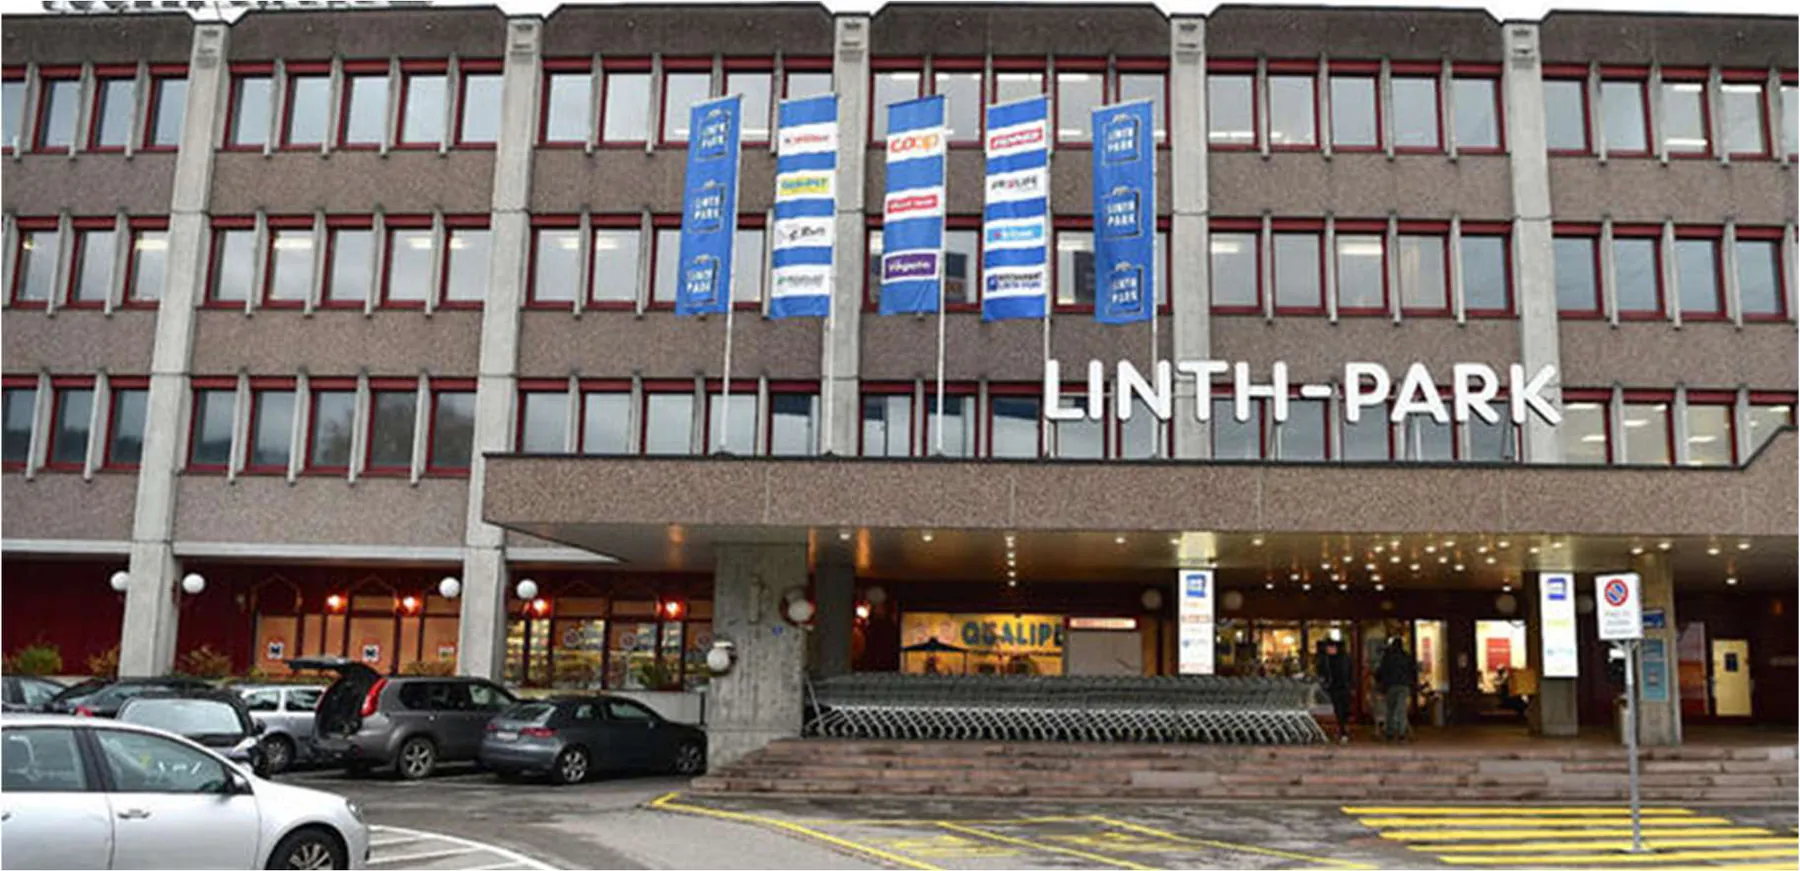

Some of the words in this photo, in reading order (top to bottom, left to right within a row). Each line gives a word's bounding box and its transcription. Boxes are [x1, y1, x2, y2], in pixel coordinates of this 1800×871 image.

[701, 135, 724, 148] PARK
[890, 133, 938, 154] coop
[1107, 140, 1134, 153] PARK
[694, 208, 720, 220] PARK
[1106, 200, 1135, 214] LINTH
[1106, 213, 1136, 227] PARK
[686, 280, 711, 293] PARK
[1111, 289, 1138, 304] PARK
[1044, 359, 1560, 426] LINTH-PARK
